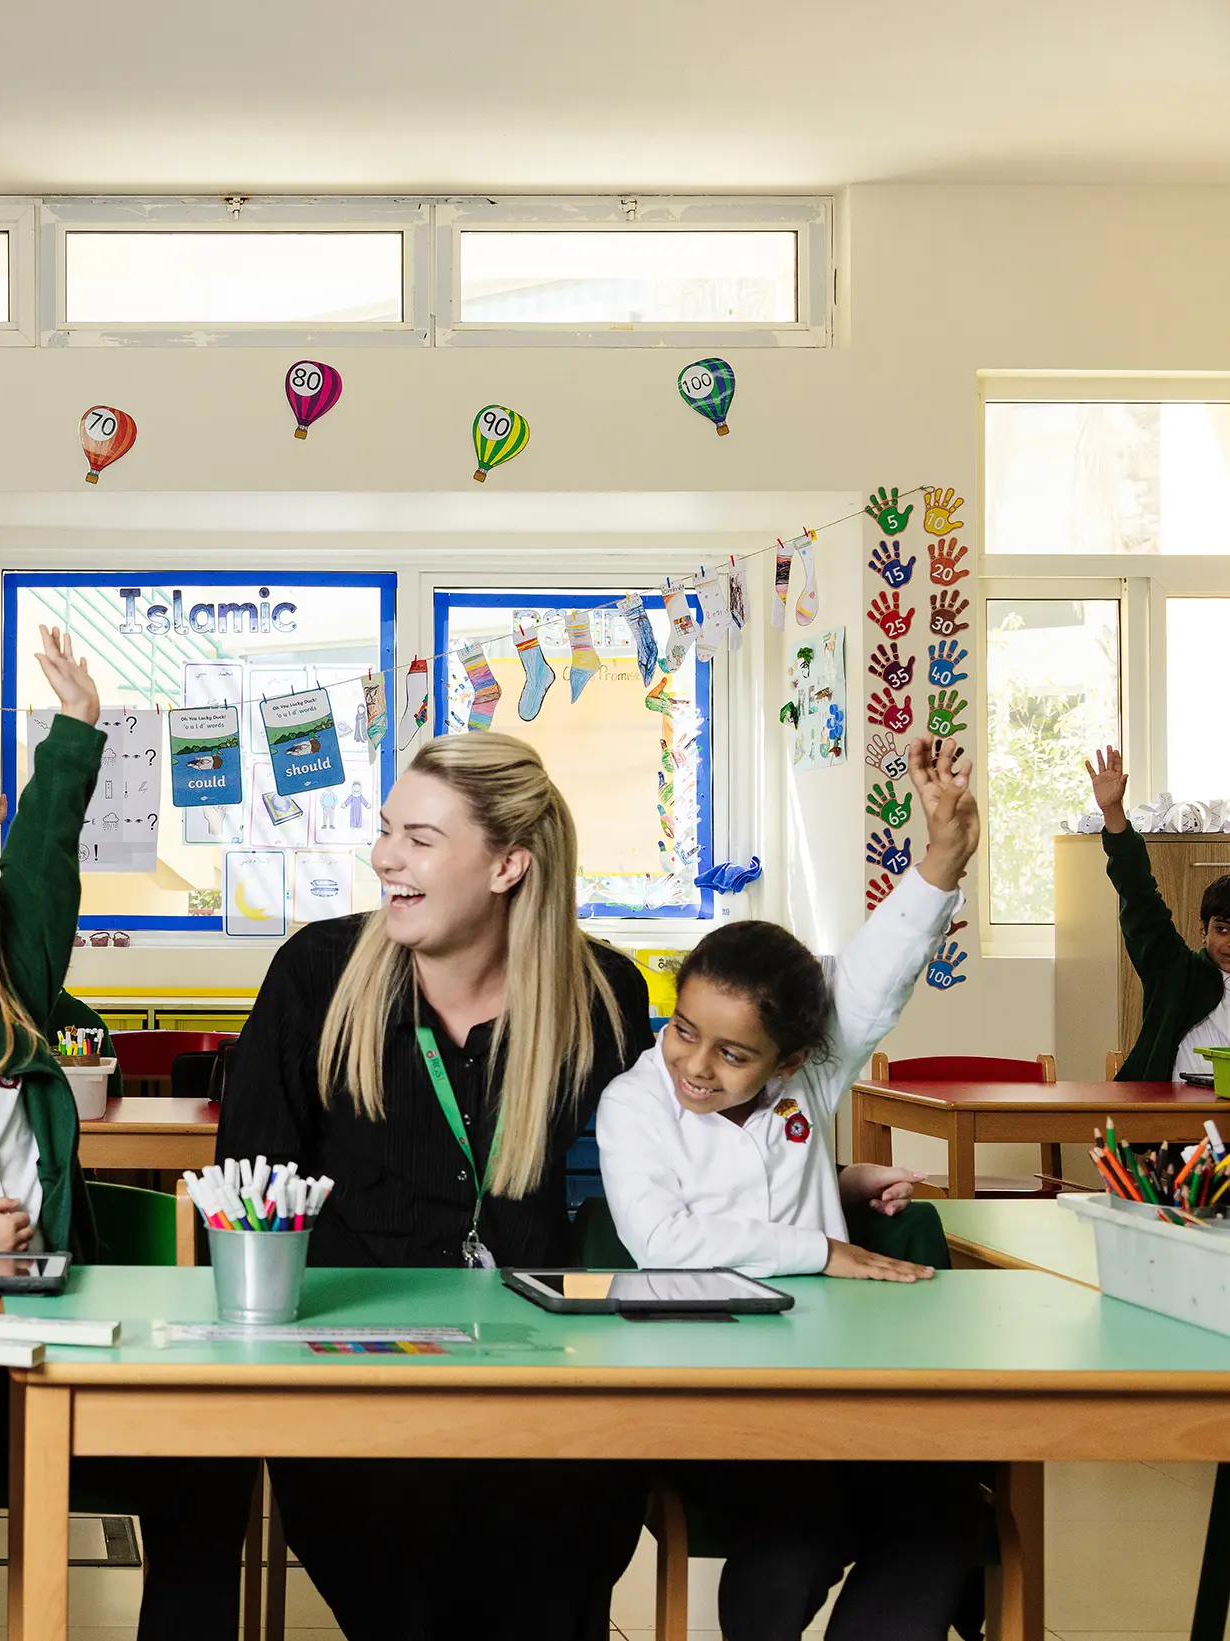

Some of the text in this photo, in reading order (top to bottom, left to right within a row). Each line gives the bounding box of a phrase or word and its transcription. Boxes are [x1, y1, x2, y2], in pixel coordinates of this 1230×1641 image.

[292, 368, 322, 390] 80
[682, 372, 712, 394] 100
[88, 412, 116, 436] 70
[482, 412, 510, 436] 90
[887, 515, 898, 529] 5
[927, 513, 945, 530] 10
[885, 567, 904, 584] 15
[932, 564, 953, 581] 20
[120, 587, 297, 635] Islamic
[885, 618, 906, 636] 25
[931, 617, 953, 634] 30
[888, 668, 909, 688] 35
[931, 666, 952, 684] 40
[890, 711, 910, 730] 45
[930, 716, 950, 734] 50
[286, 757, 331, 777] should
[885, 758, 906, 777] 55
[188, 775, 226, 788] could
[888, 806, 908, 826] 65
[887, 852, 908, 873] 75
[928, 968, 952, 986] 100
[431, 1058, 444, 1078] RGS
